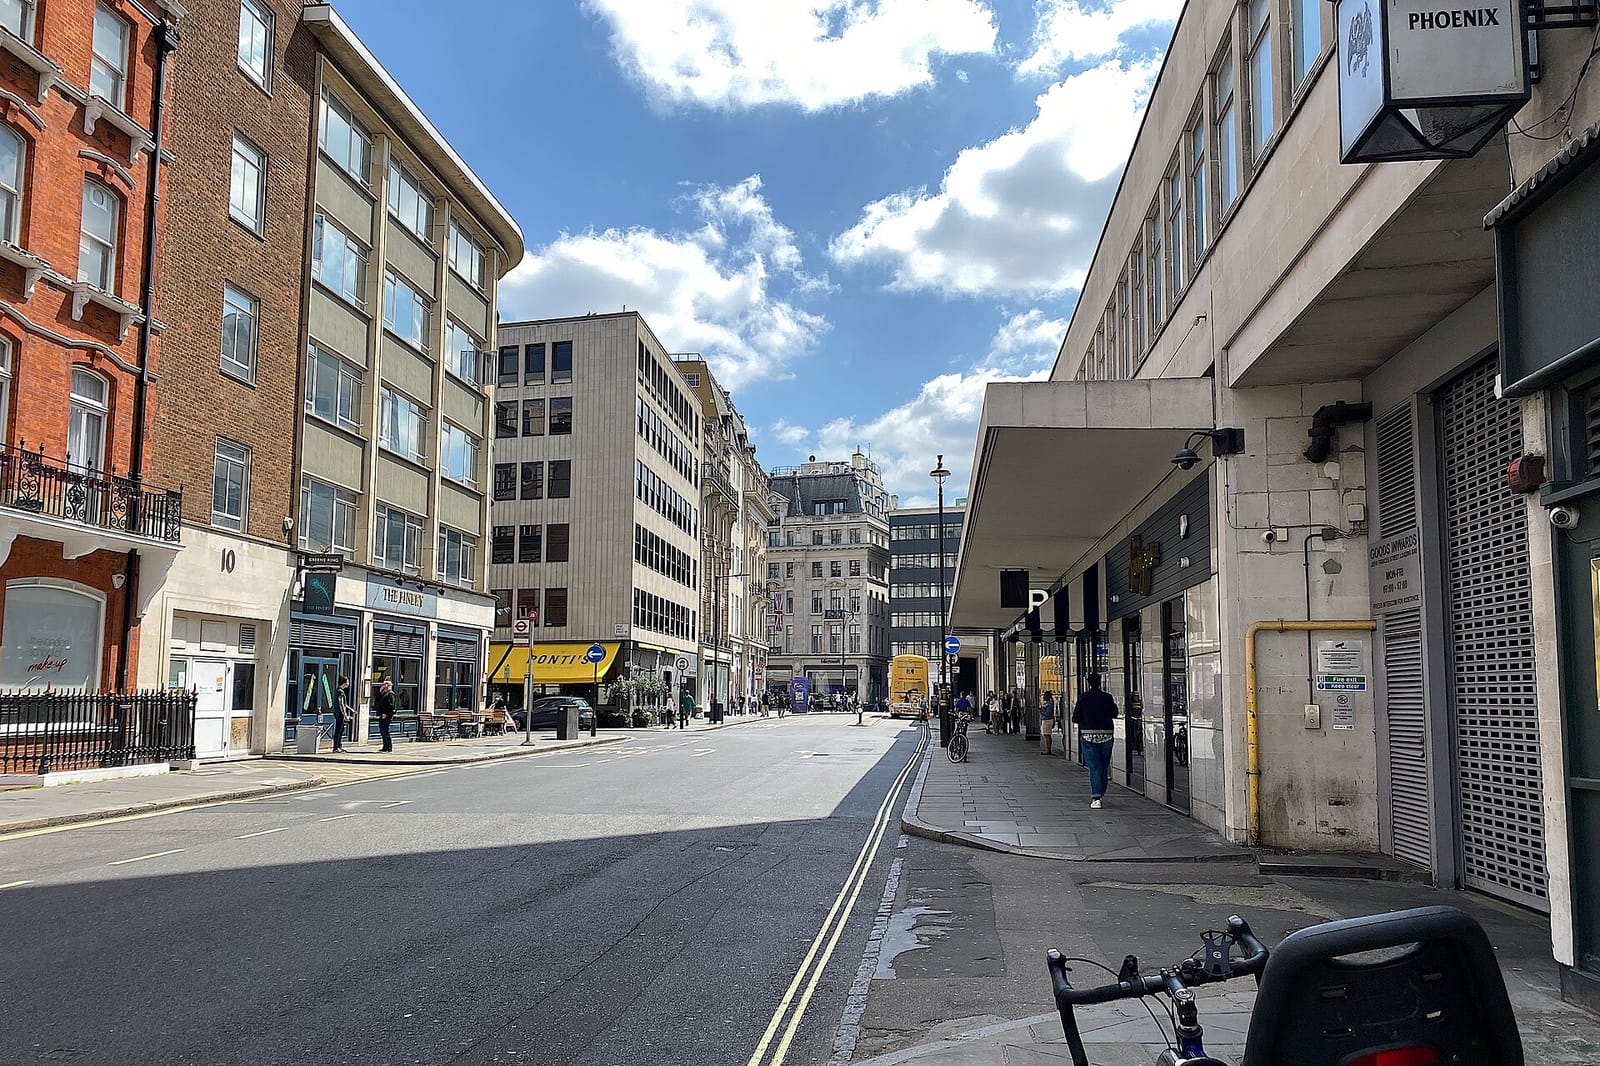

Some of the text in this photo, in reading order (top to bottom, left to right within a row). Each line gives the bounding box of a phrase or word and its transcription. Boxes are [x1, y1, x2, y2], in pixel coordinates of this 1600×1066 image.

[1408, 8, 1500, 30] PHOENIX
[1370, 534, 1417, 559] GOODS INWARDS
[220, 548, 236, 574] 10
[383, 586, 424, 608] THE FINERY
[526, 654, 589, 665] PONTI'S
